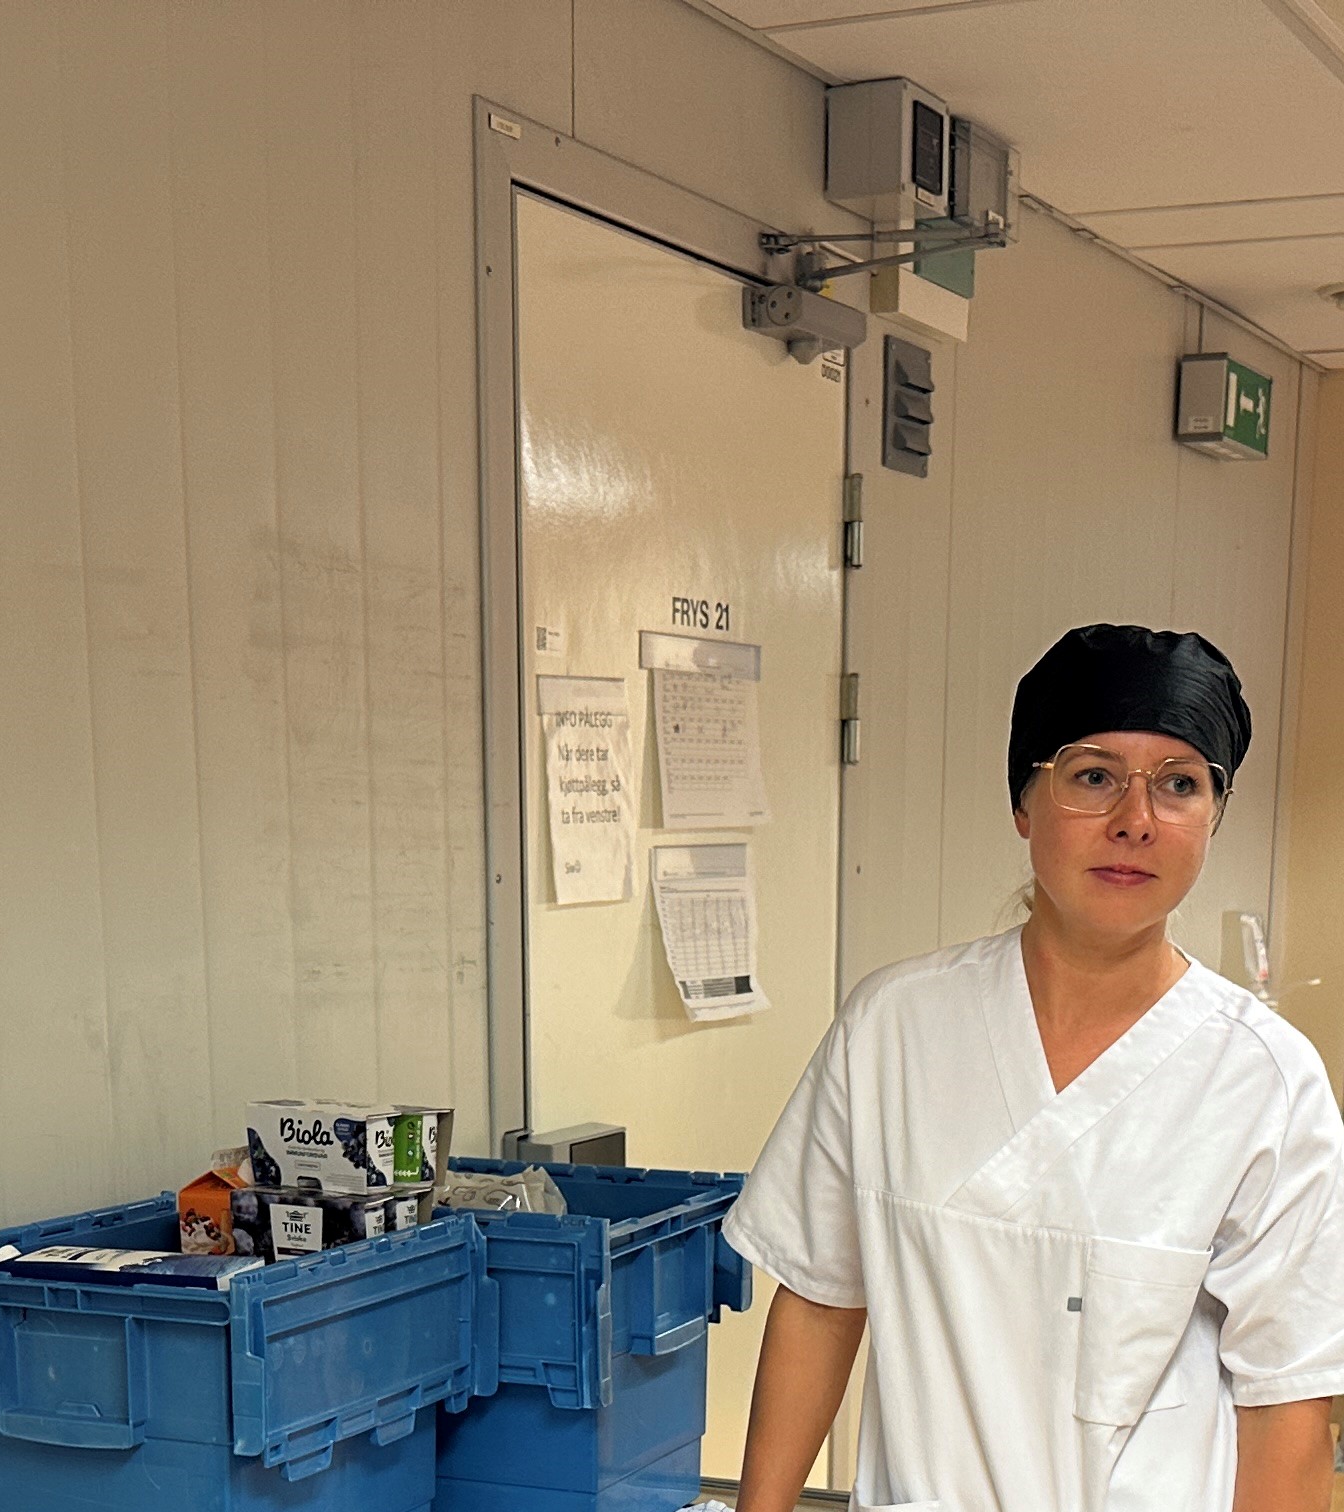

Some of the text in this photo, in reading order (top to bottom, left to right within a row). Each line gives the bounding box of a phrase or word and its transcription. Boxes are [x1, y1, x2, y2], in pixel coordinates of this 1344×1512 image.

[672, 596, 730, 631] FRYS 21
[556, 705, 613, 728] INFO PÅLEGG
[561, 810, 571, 824] ta
[572, 806, 584, 824] fra
[279, 1117, 334, 1146] Biola
[282, 1221, 312, 1235] TINE
